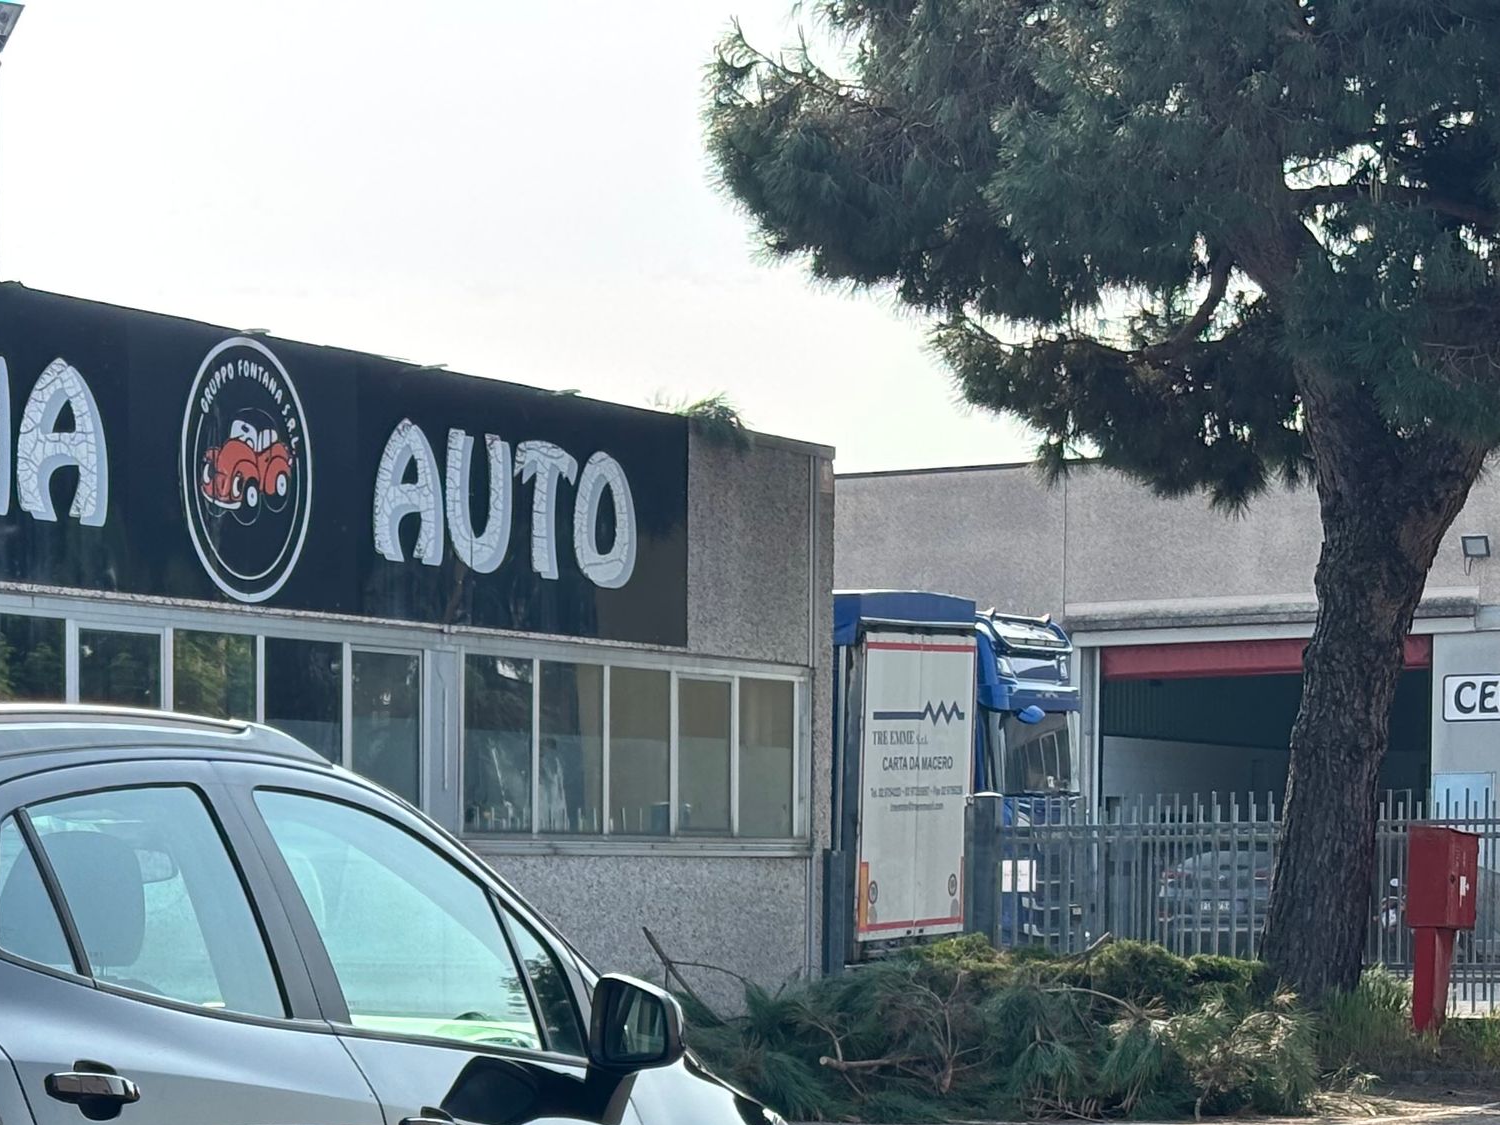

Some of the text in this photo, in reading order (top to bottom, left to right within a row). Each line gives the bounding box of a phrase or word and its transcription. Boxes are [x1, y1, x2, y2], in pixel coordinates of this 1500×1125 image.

[201, 362, 234, 413] GRUPPO
[238, 359, 282, 404] FONTANA
[374, 418, 638, 589] AUTO
[1454, 681, 1499, 714] CE
[872, 731, 888, 745] TRE
[890, 730, 915, 745] EMME
[882, 756, 954, 771] CARTA DA MACERO
